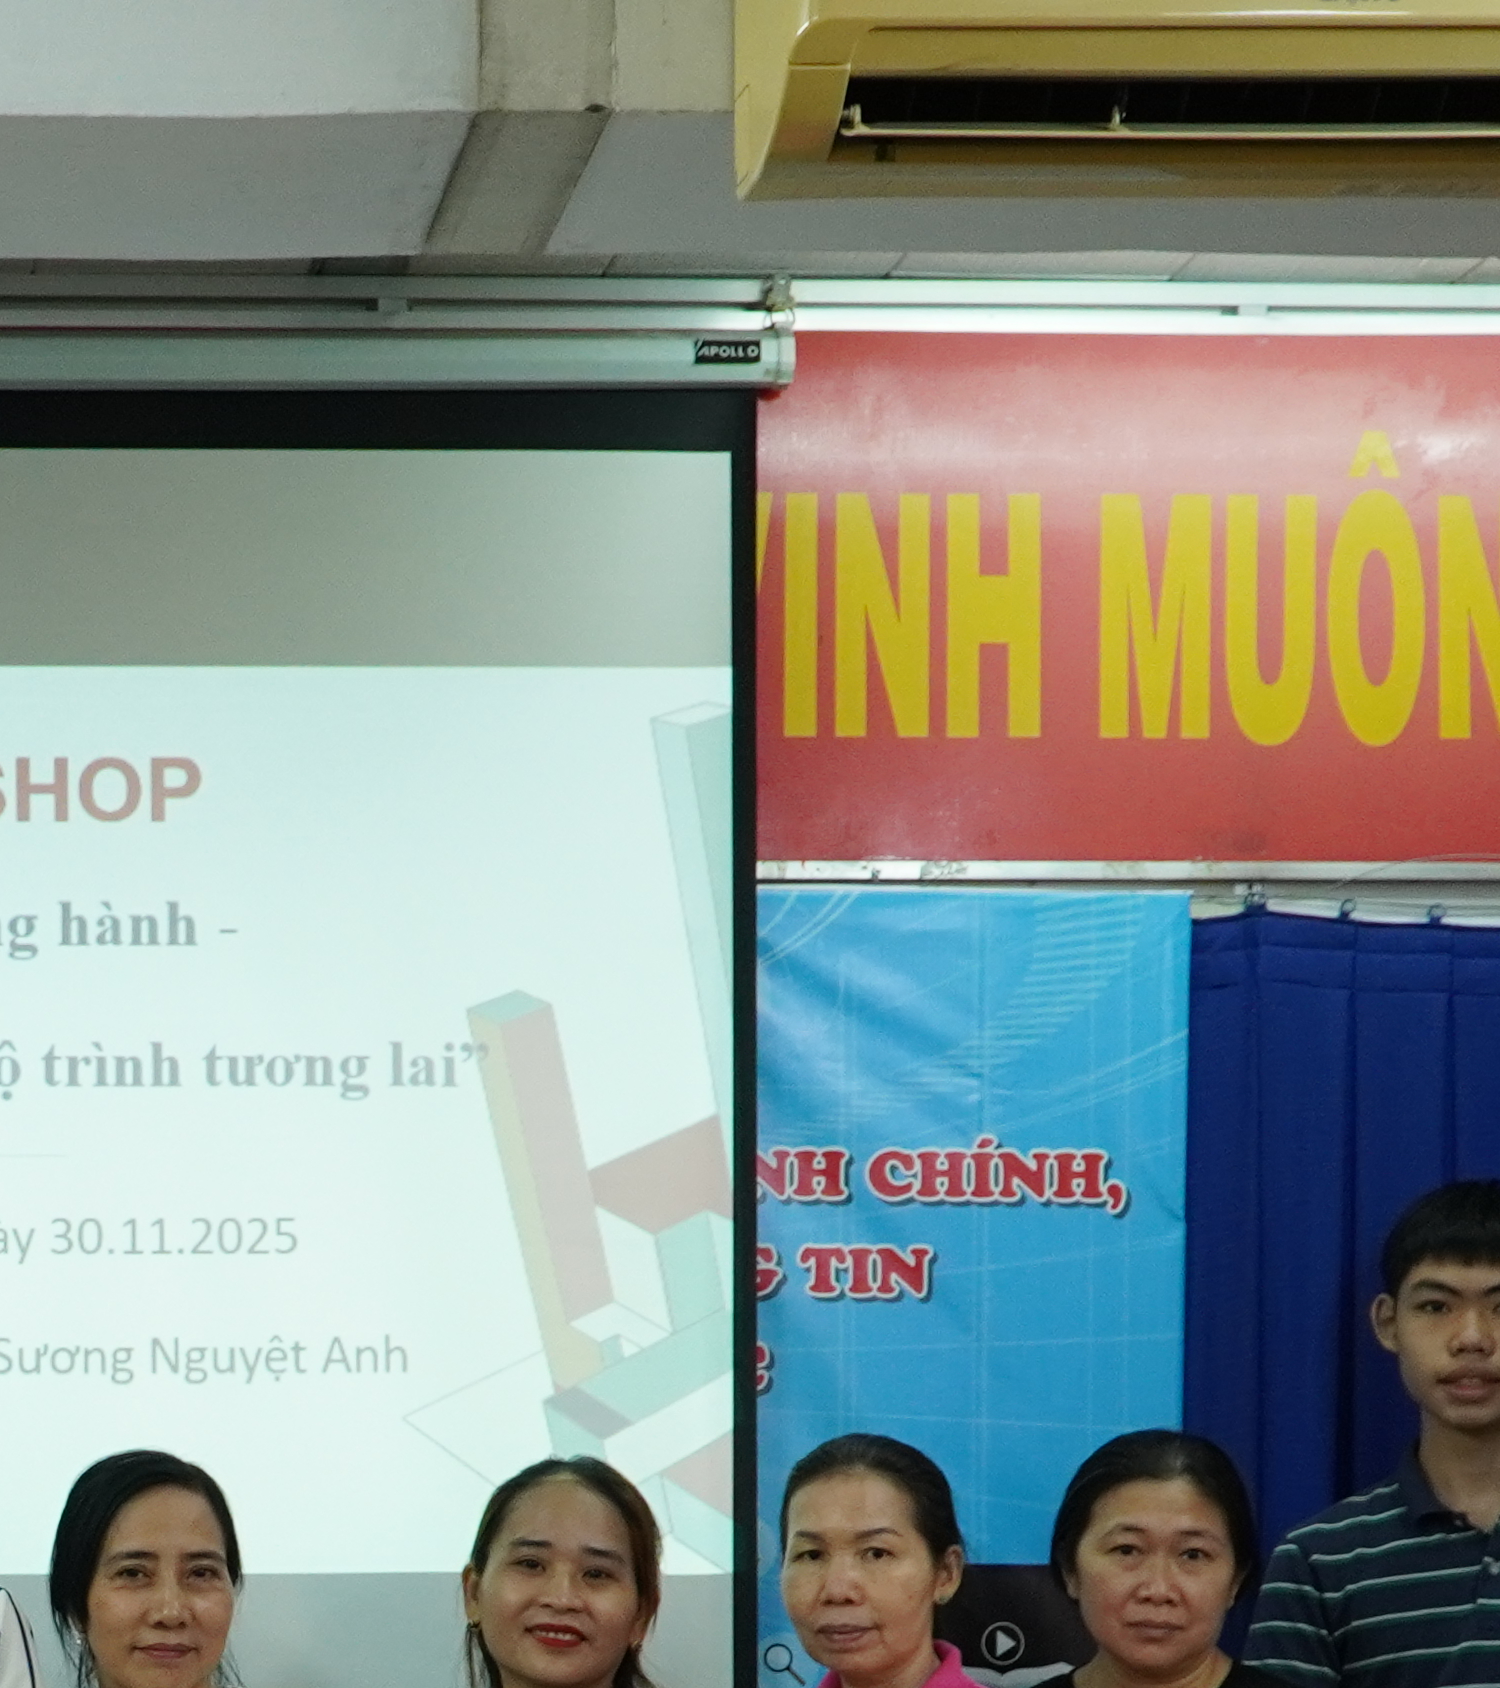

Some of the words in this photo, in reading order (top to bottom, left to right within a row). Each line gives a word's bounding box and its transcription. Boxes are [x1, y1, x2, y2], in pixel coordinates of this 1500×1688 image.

[696, 341, 760, 358] APOLLO
[756, 491, 1042, 739] INH
[58, 901, 198, 947] hành
[42, 1042, 182, 1088] trình
[203, 1044, 371, 1101] tương
[389, 1042, 490, 1088] lai”
[867, 1135, 1128, 1214] CHÍNH,
[51, 1216, 298, 1256] 30.11.2025
[799, 1245, 934, 1297] TIN
[150, 1335, 308, 1384] Nguyệt
[322, 1334, 409, 1374] Anh
